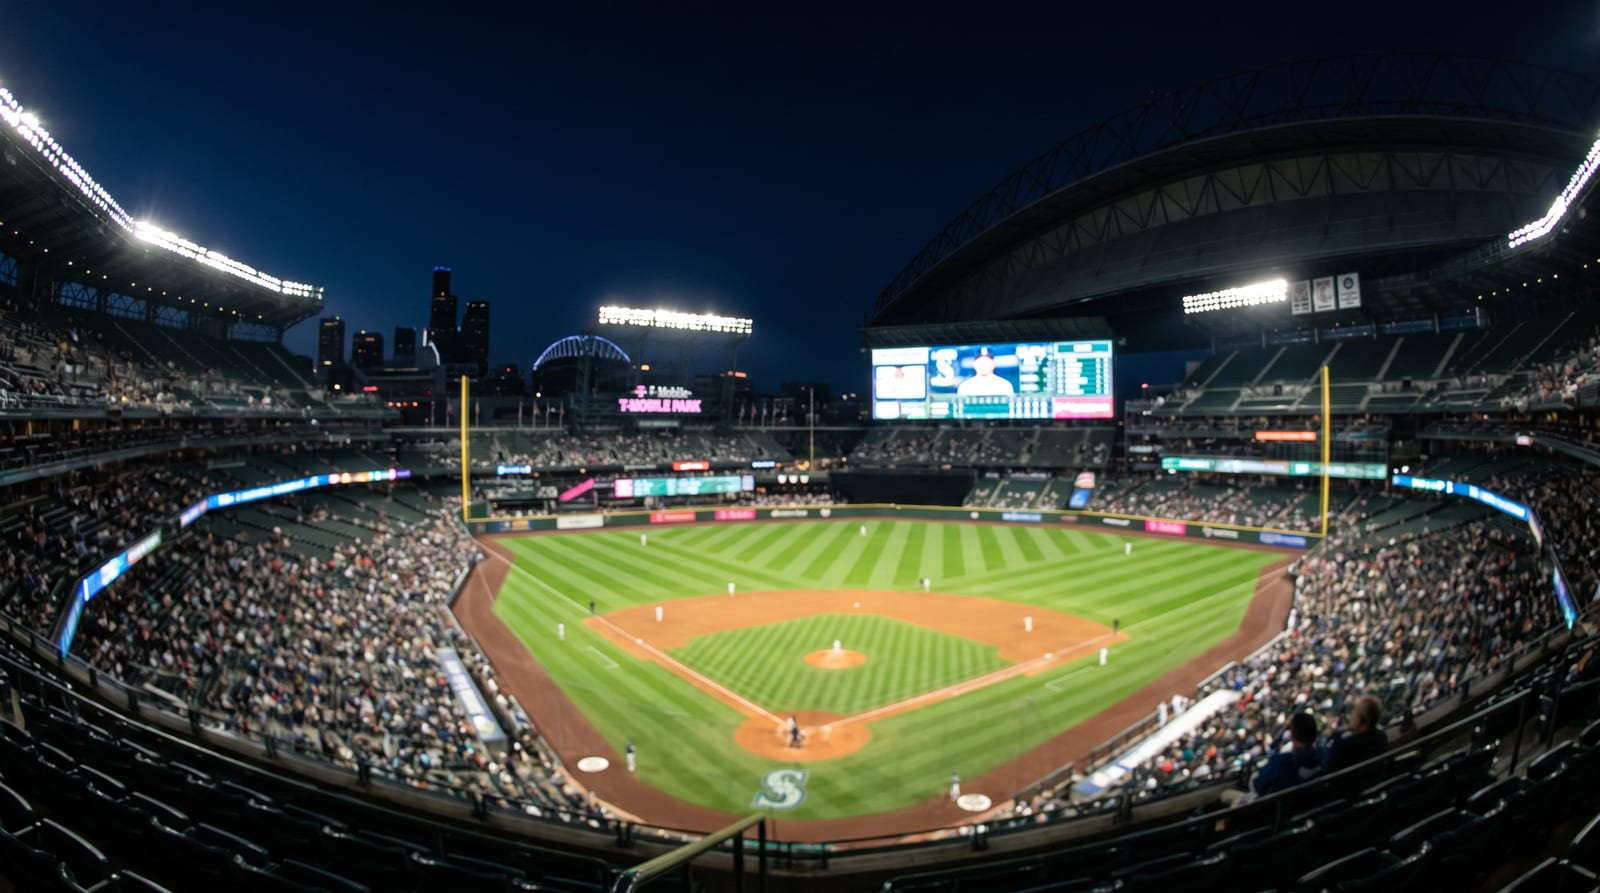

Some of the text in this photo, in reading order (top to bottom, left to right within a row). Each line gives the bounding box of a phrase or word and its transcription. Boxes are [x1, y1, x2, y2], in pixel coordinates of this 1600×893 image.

[618, 399, 702, 412] T-MOBILE PARK
[751, 768, 810, 810] S
